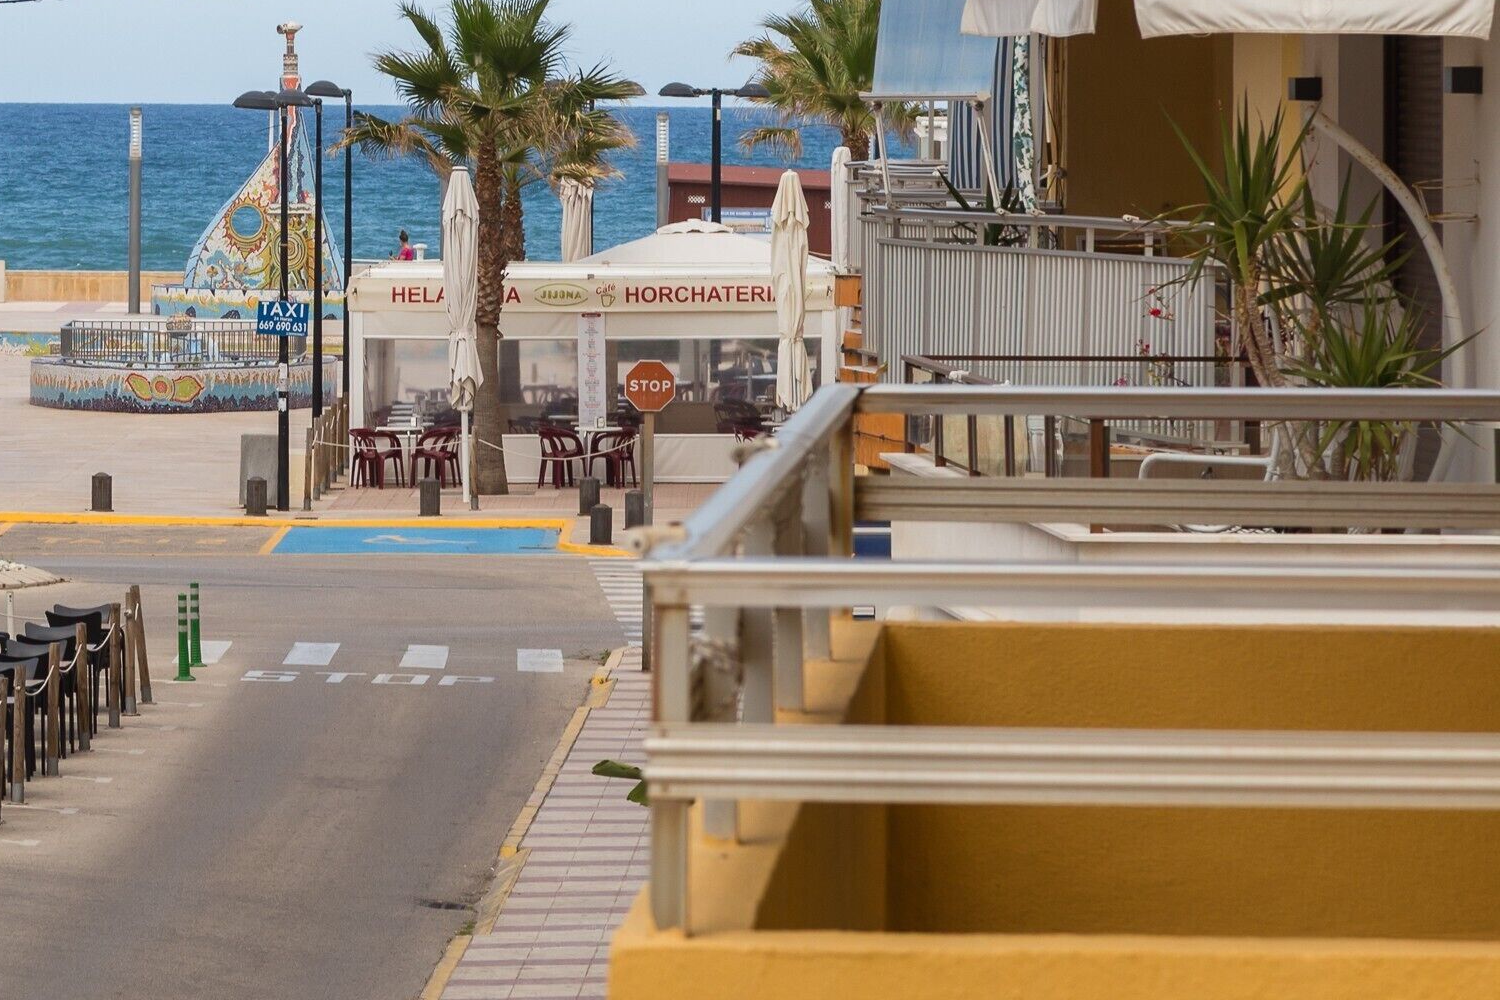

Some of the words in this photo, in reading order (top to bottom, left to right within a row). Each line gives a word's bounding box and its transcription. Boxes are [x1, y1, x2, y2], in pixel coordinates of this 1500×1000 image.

[540, 292, 582, 300] JIJONA
[625, 286, 775, 304] HORCHATERI
[262, 301, 304, 318] TAXI
[259, 320, 274, 331] 669
[276, 321, 291, 332] 690
[293, 322, 306, 333] 631
[629, 379, 671, 393] STOP
[240, 670, 495, 686] STOP
